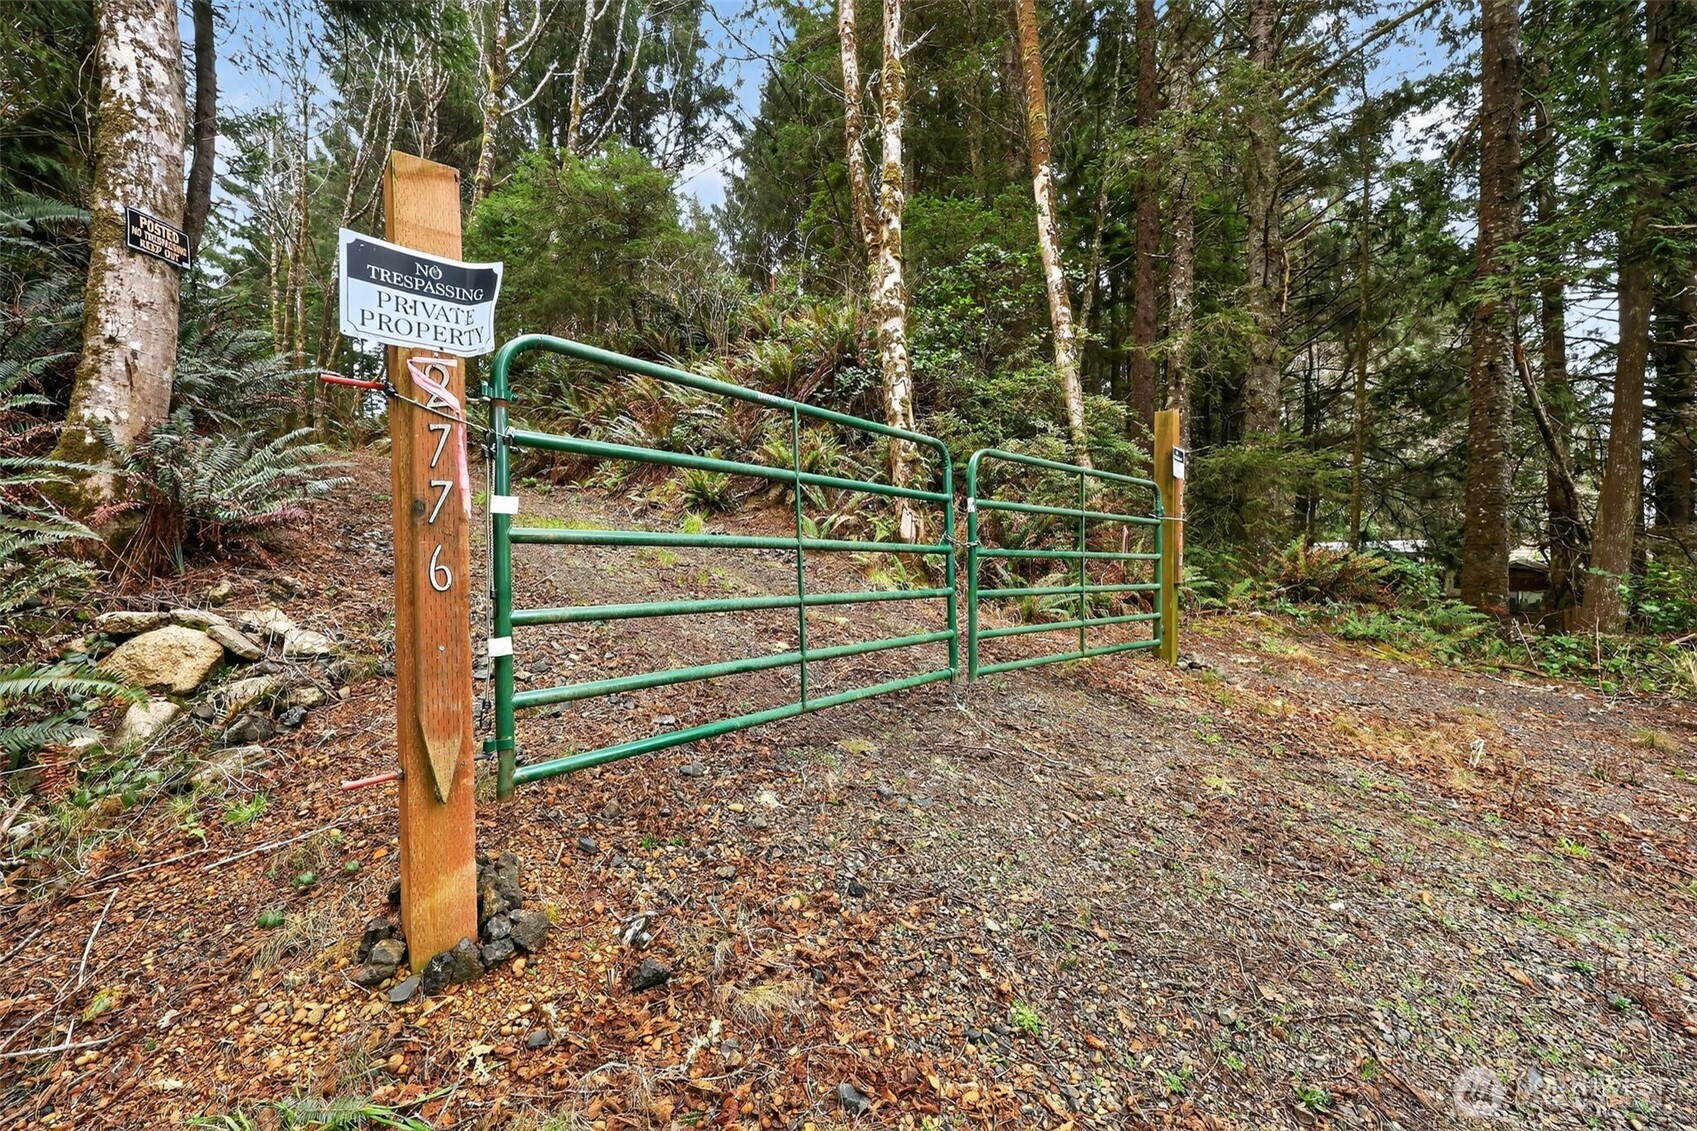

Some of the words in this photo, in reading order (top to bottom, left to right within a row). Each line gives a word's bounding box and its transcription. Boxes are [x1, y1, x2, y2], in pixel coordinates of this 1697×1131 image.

[131, 225, 142, 237] NO
[139, 215, 180, 244] POSTED
[164, 249, 180, 262] OUT
[366, 263, 484, 302] TRESPASSING
[415, 261, 443, 280] NO
[376, 290, 475, 326] PRIVATE
[359, 308, 484, 346] PROPERTY
